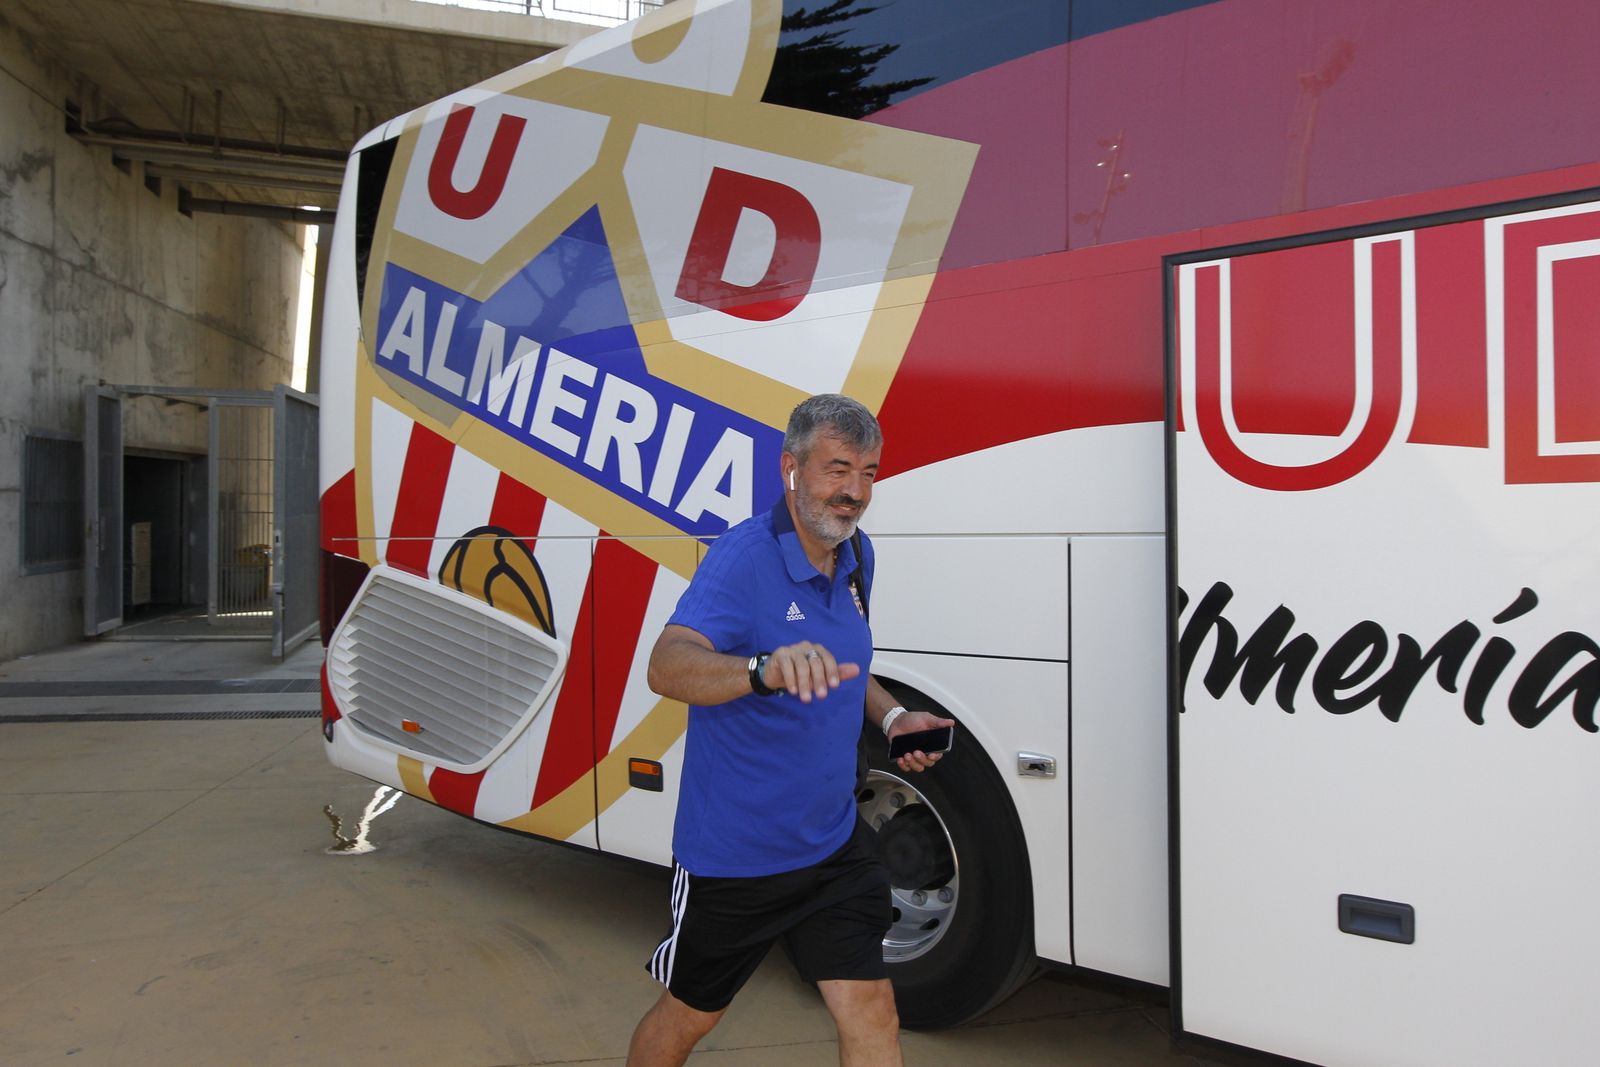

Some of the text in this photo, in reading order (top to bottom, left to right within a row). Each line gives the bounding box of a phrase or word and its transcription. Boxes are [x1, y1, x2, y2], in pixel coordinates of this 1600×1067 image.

[427, 102, 821, 321] U D
[379, 286, 754, 529] ALMERIA
[786, 613, 805, 621] adidas
[1178, 581, 1600, 733] lmería
